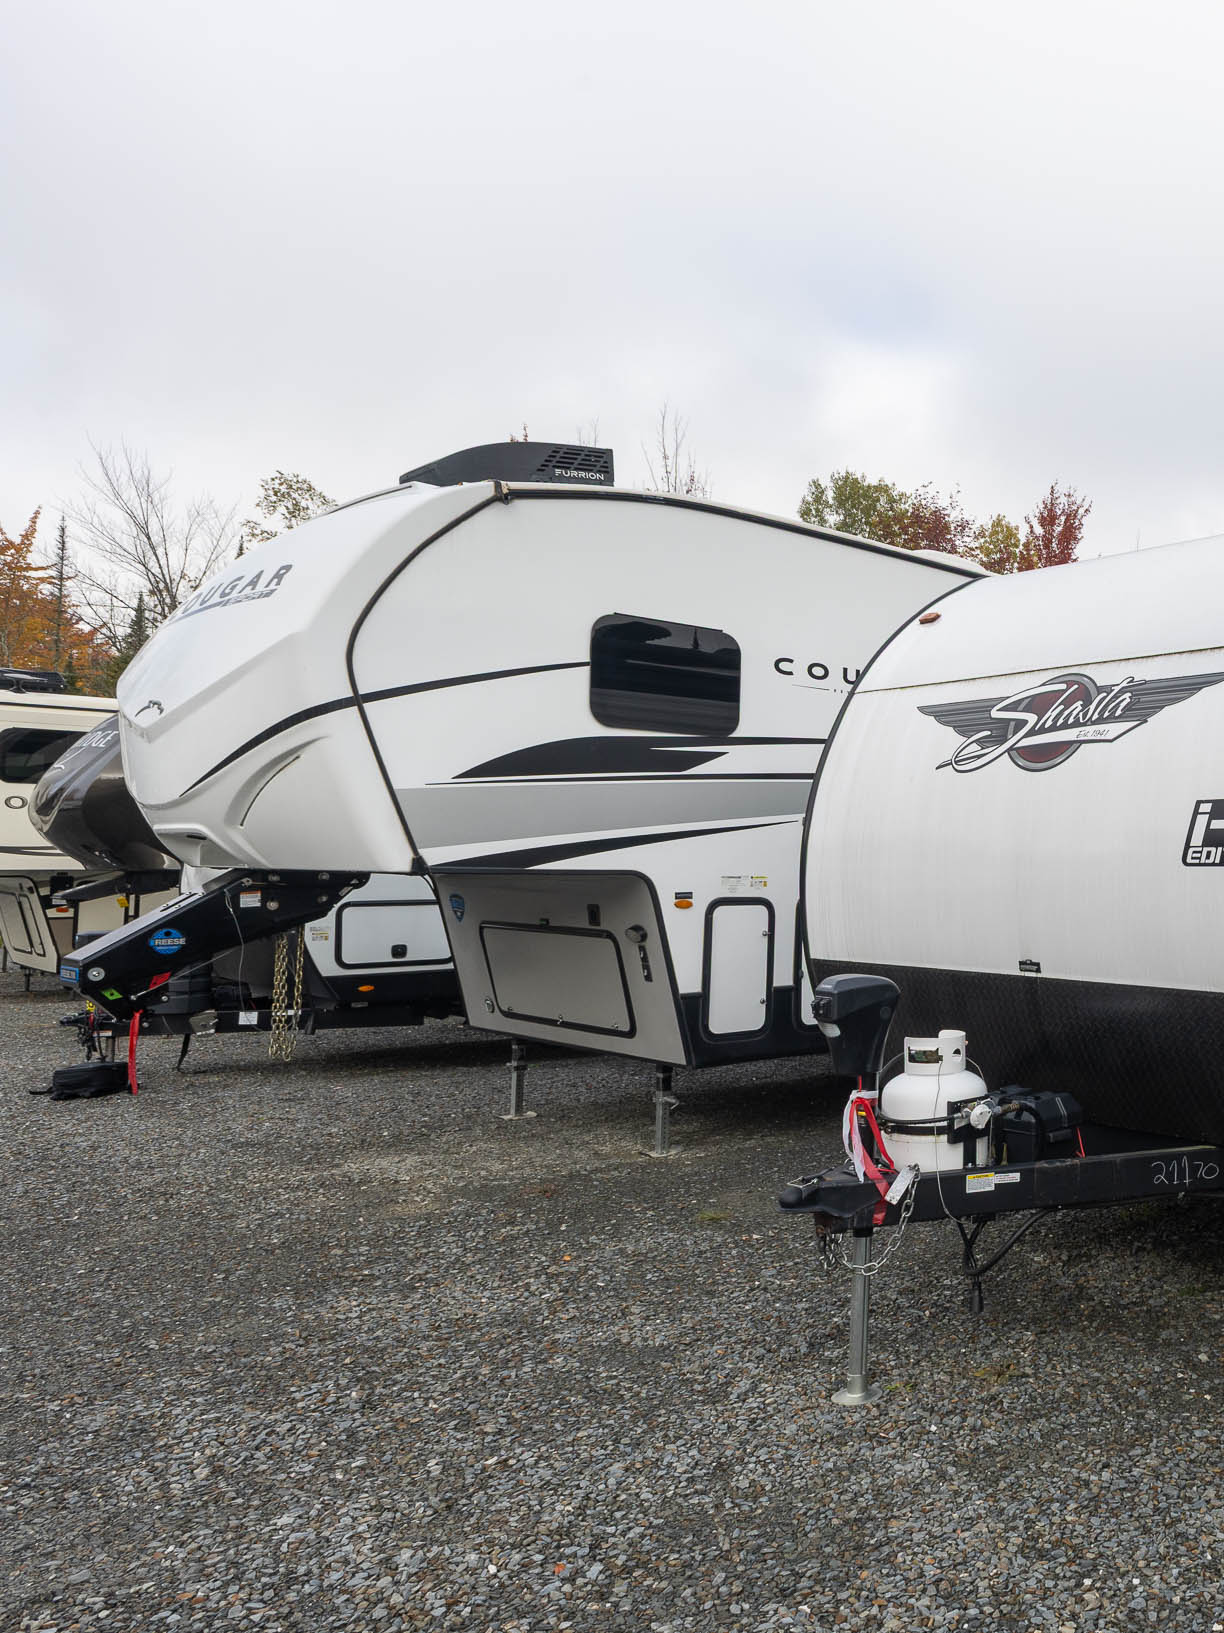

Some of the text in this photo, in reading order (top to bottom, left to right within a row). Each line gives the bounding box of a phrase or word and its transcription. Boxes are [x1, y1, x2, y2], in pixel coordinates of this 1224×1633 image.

[555, 469, 604, 480] FURRION
[166, 564, 293, 621] OUGAR
[952, 676, 1147, 773] Shasta
[154, 937, 186, 946] REESE
